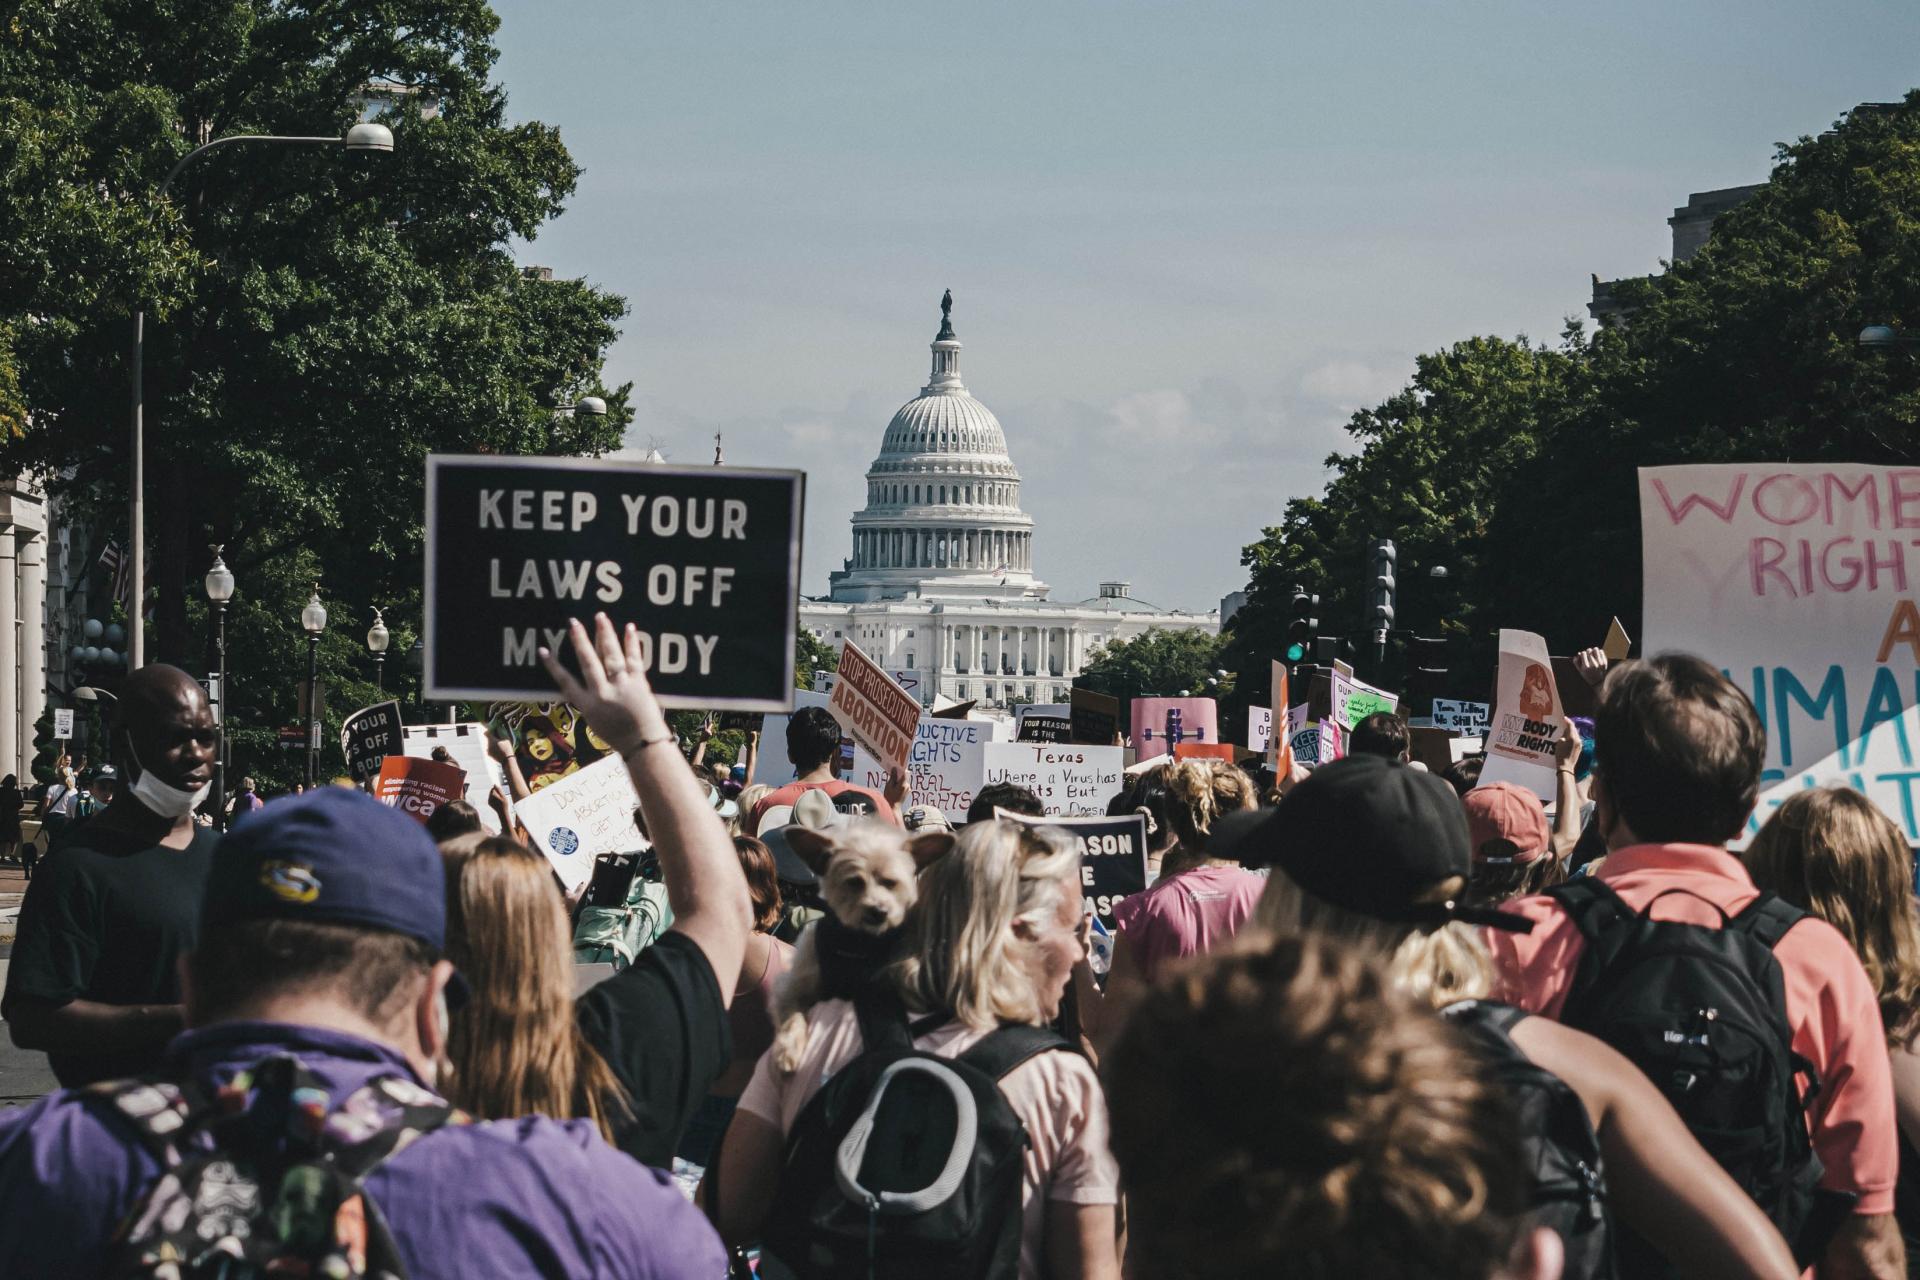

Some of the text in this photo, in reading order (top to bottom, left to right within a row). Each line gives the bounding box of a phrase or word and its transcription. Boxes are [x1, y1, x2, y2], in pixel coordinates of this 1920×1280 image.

[479, 488, 748, 540] KEEP YOUR
[1751, 535, 1920, 598] RIGH
[490, 558, 735, 607] LAWS OFF
[503, 627, 719, 675] MY ODY
[841, 649, 918, 735] STOP PROSECUTING
[352, 712, 388, 734] YOUR
[832, 681, 909, 767] ABORTION
[1024, 720, 1071, 730] YOUR REASON
[1502, 713, 1558, 738] MY BODY
[364, 732, 389, 749] OFF
[1041, 731, 1056, 739] THE
[1496, 729, 1520, 744] MY
[1516, 734, 1557, 755] RIGHTS
[356, 753, 388, 773] BOD
[1032, 746, 1085, 763] Texas
[988, 768, 1117, 785] Where a Virus has
[420, 781, 447, 795] racism
[1067, 784, 1098, 798] But
